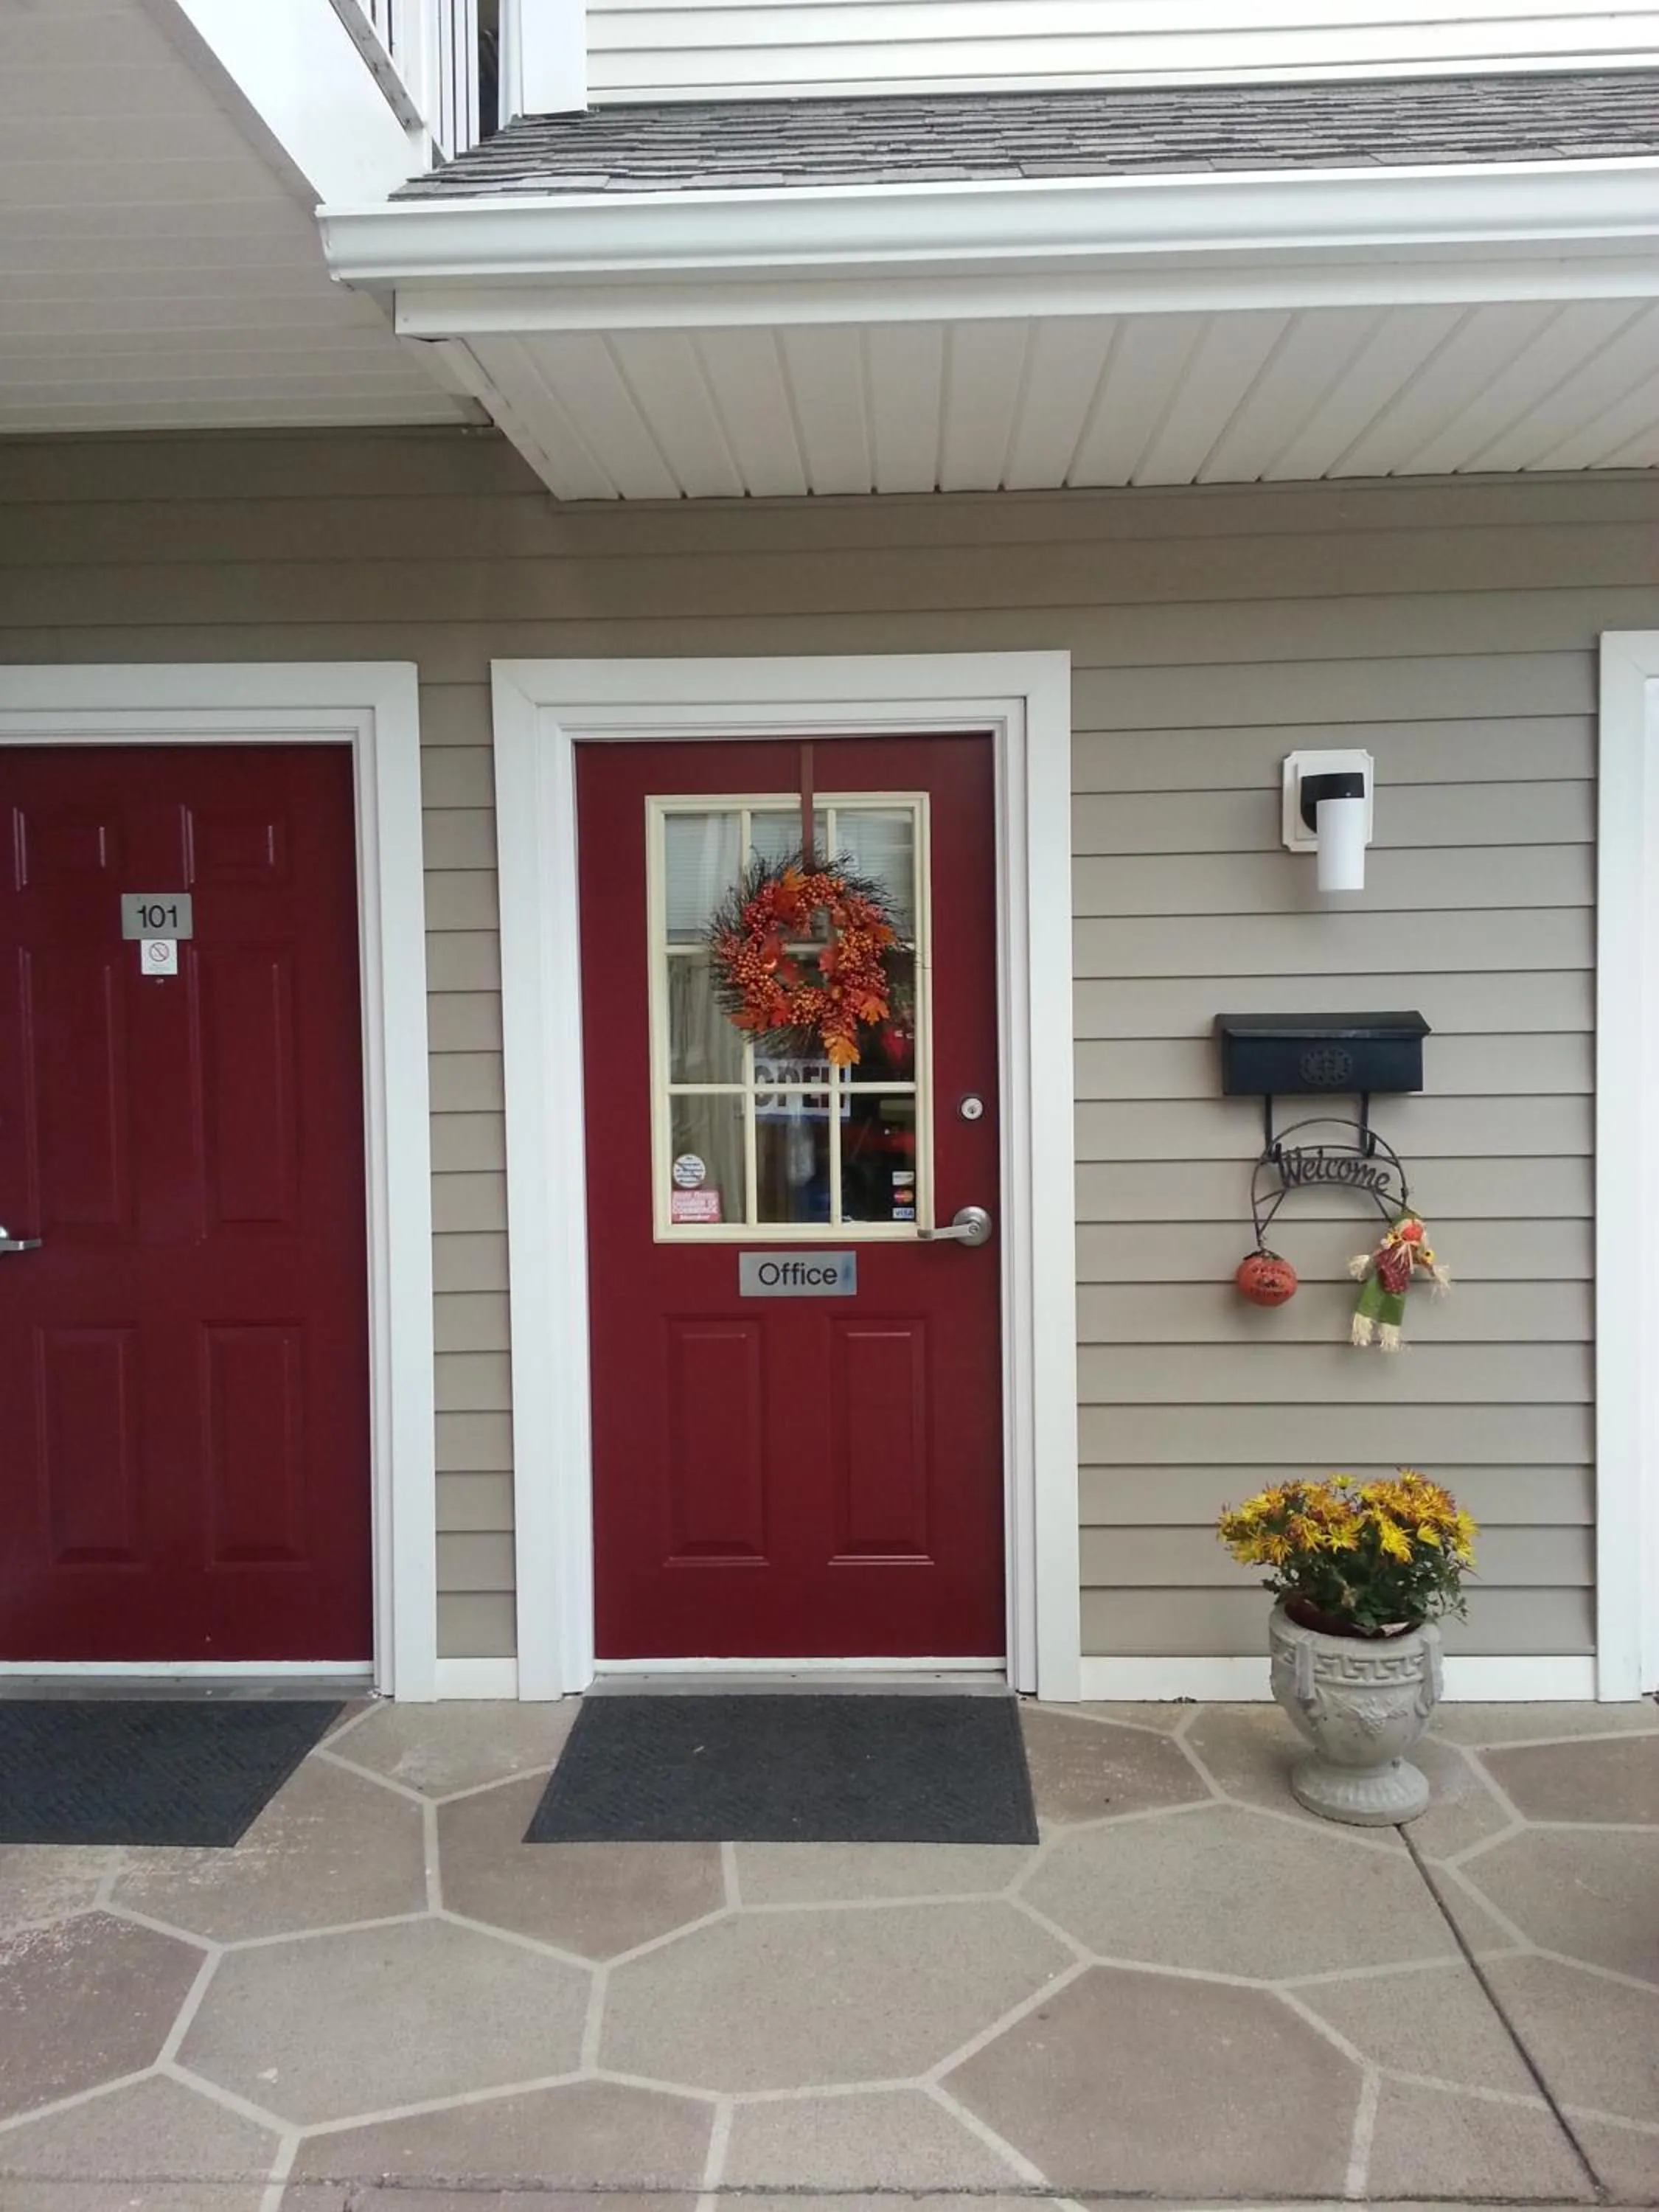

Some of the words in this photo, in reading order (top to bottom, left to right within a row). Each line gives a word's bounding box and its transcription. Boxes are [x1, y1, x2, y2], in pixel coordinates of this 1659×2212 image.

[136, 904, 178, 928] 101
[1279, 1146, 1391, 1193] Welcome
[758, 1262, 838, 1286] Office
